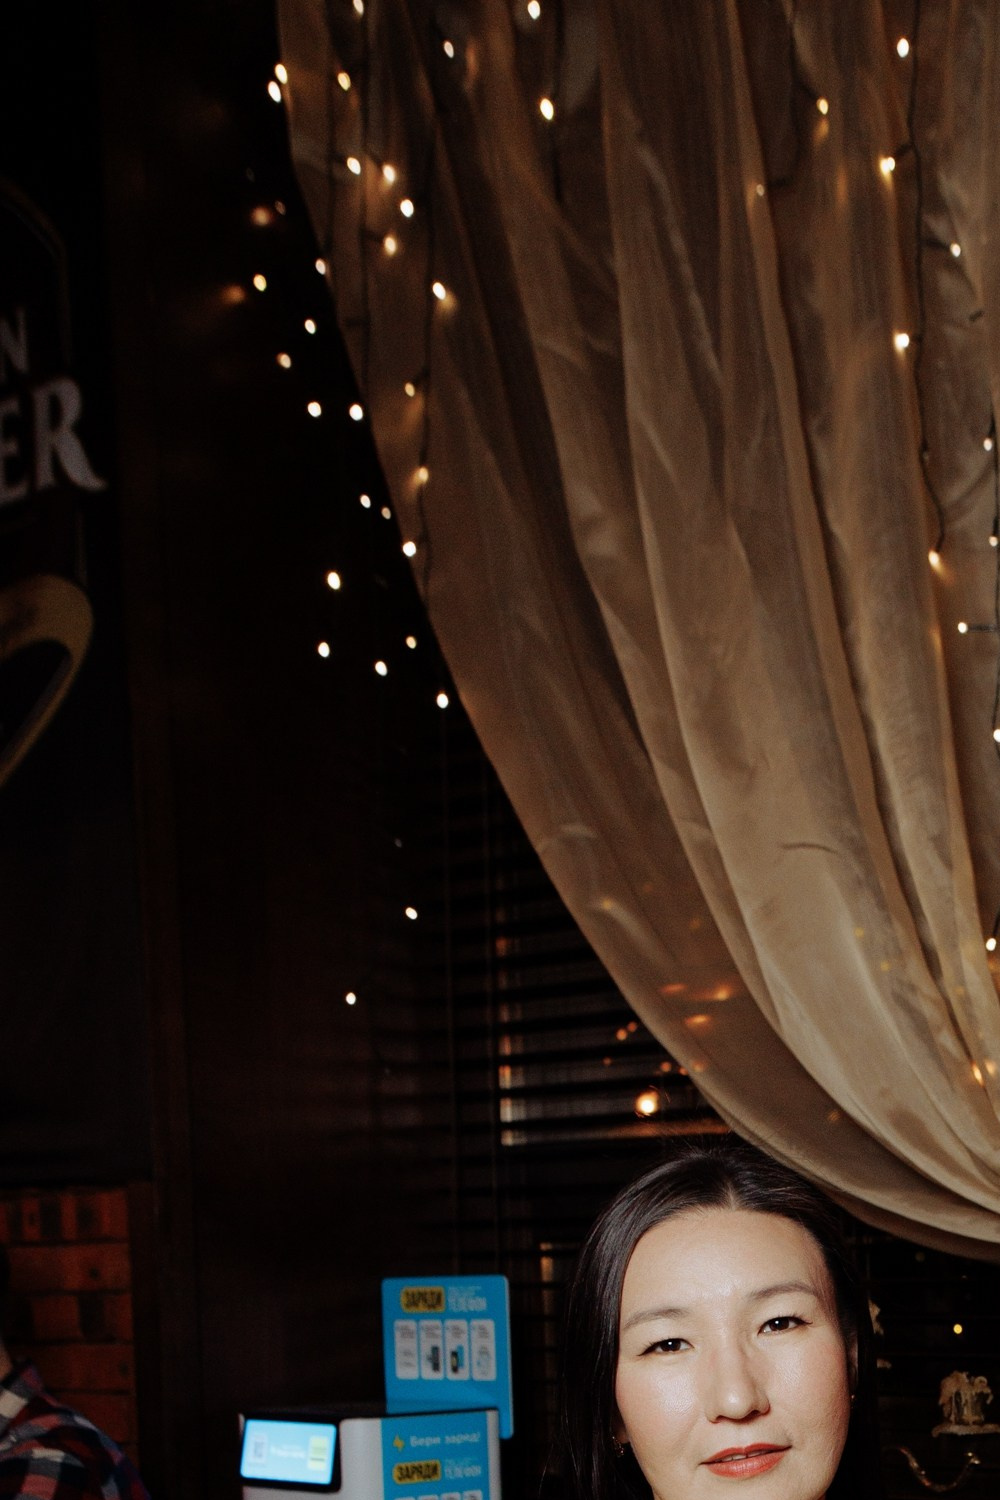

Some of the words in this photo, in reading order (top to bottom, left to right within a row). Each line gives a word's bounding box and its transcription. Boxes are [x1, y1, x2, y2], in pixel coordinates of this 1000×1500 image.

[405, 1289, 443, 1311] ЗАРЯДИ
[410, 1435, 441, 1448] Бери
[397, 1462, 438, 1481] ЗАРЯДИ
